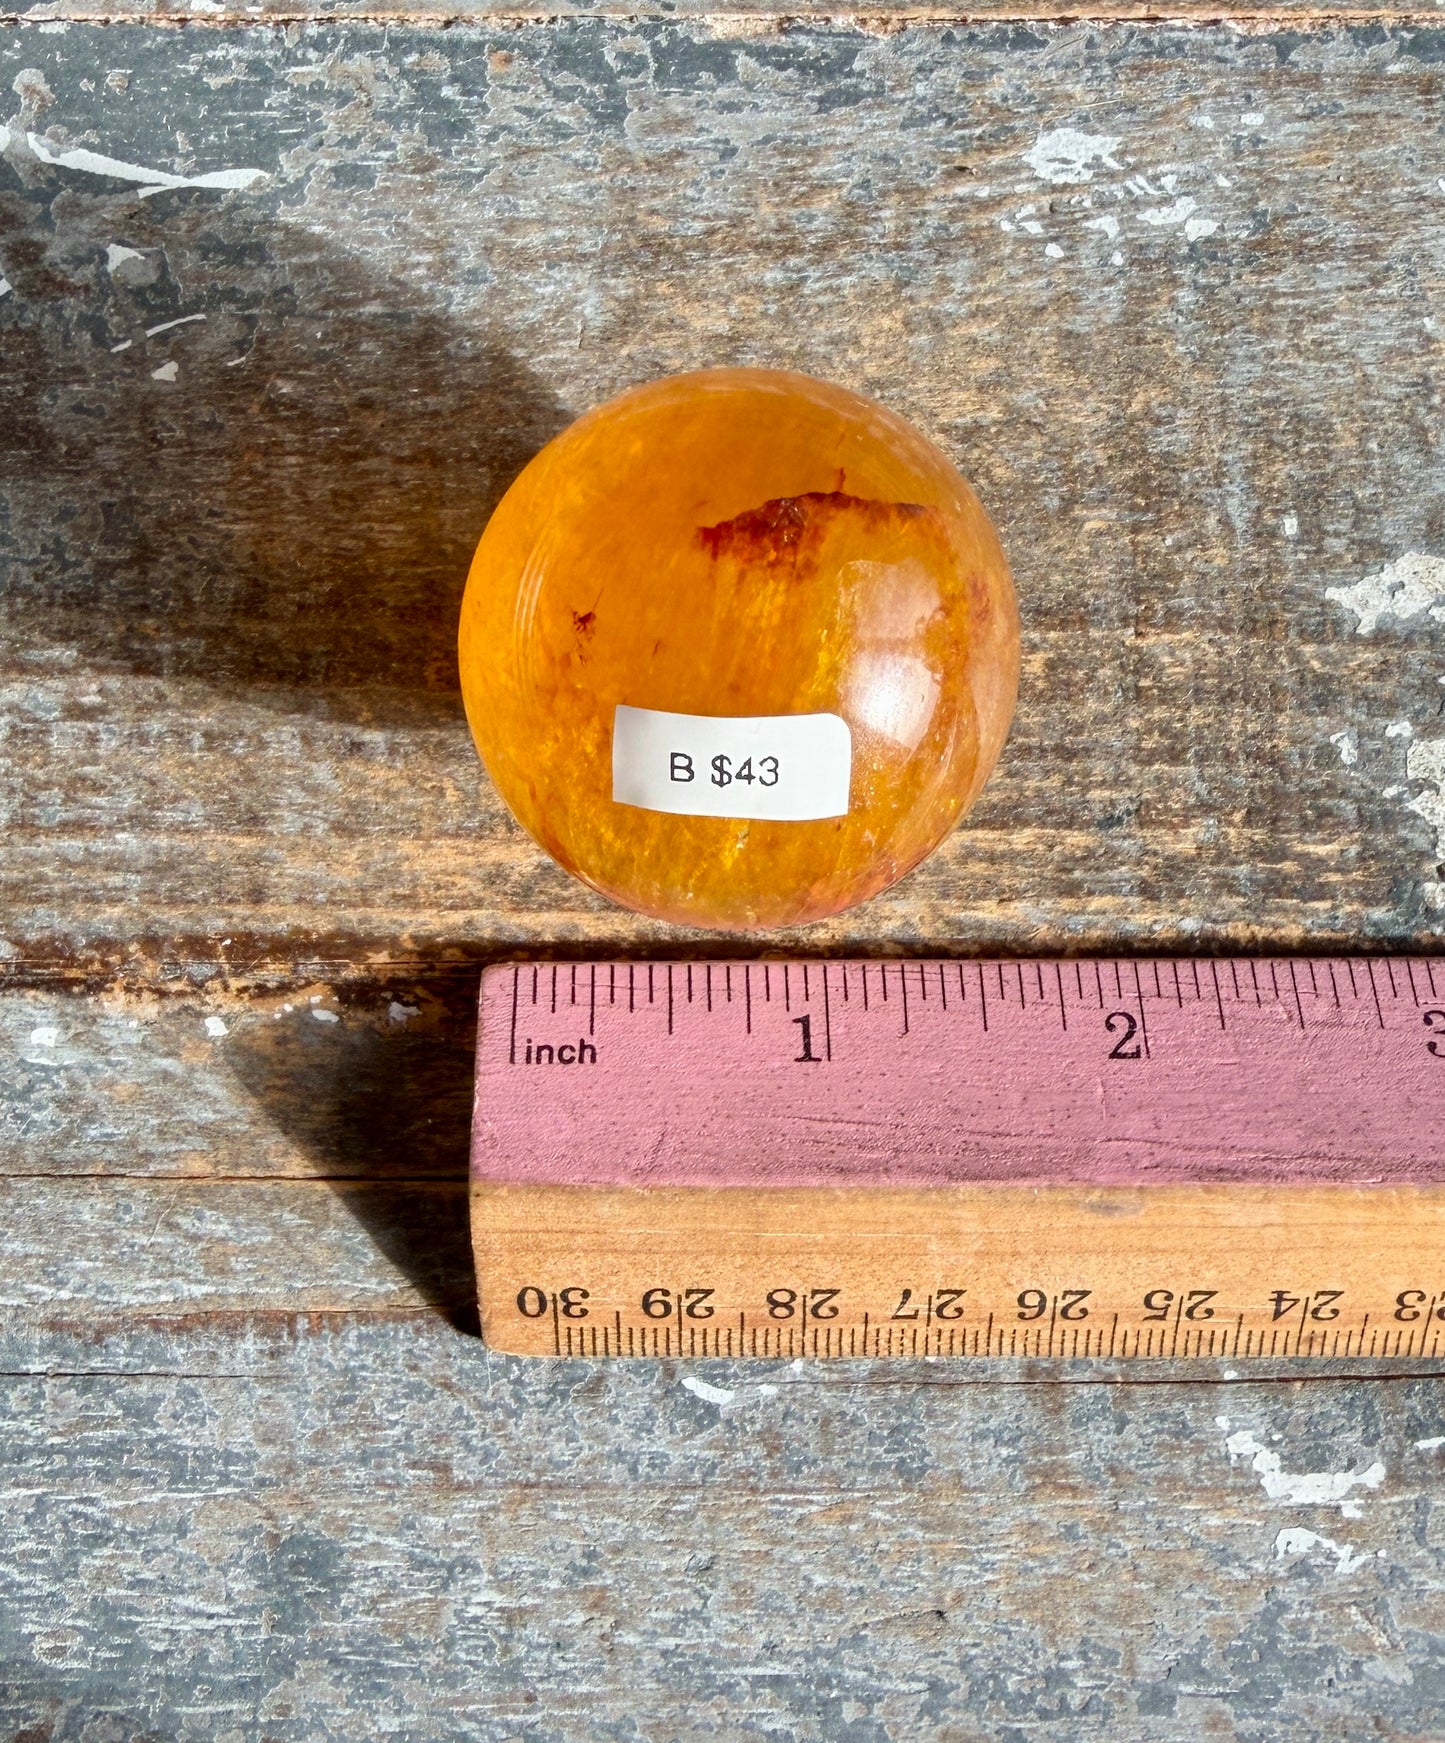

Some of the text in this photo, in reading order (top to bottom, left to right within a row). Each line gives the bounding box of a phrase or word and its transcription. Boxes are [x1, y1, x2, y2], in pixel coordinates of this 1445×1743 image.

[670, 752, 779, 787] B $43
[526, 1038, 597, 1065] inch
[792, 1014, 822, 1062] 1
[1105, 1011, 1141, 1060] 2
[517, 1286, 590, 1320] 30
[642, 1287, 715, 1320] 29
[766, 1287, 841, 1320] 28
[891, 1288, 968, 1321] 27
[1017, 1289, 1093, 1321] 26
[1143, 1289, 1219, 1322] 25
[1268, 1289, 1345, 1322] 24
